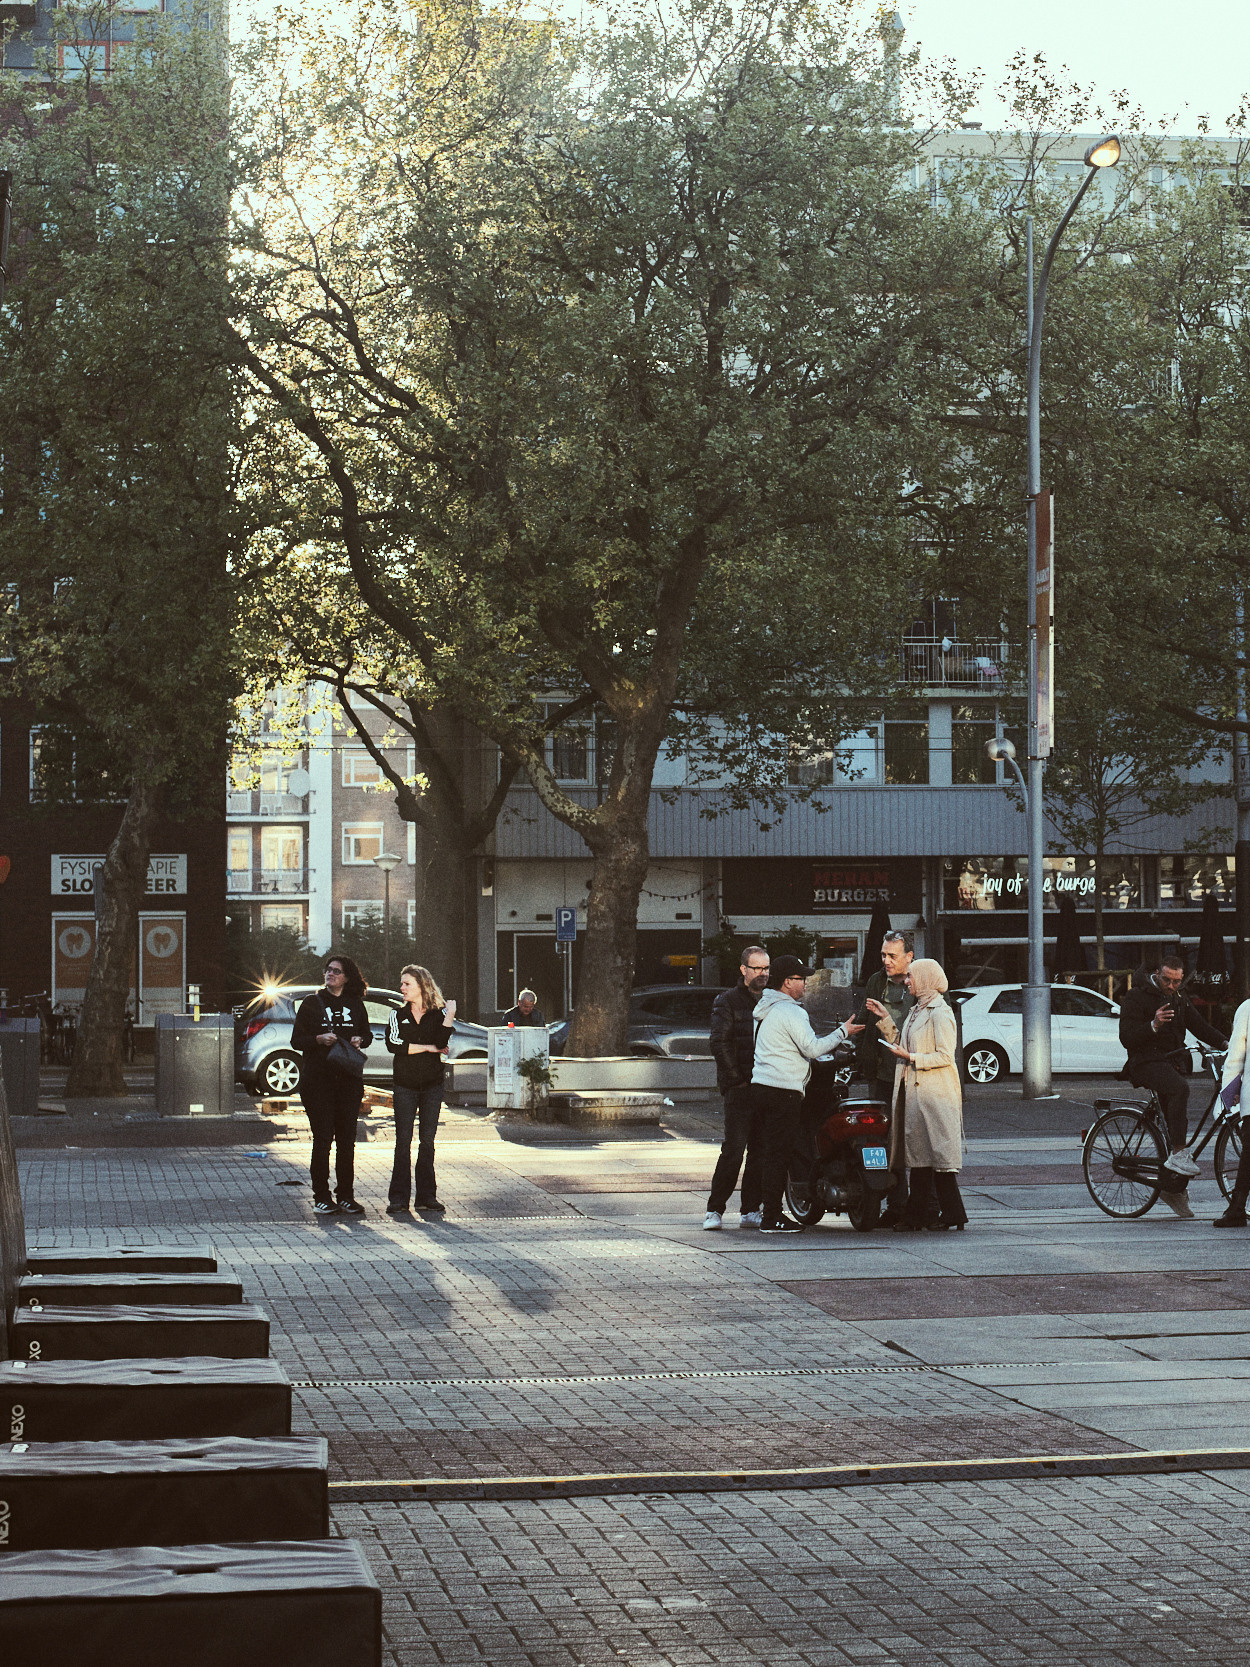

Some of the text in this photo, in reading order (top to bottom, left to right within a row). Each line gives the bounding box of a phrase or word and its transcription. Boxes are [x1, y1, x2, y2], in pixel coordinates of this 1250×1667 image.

[60, 861, 177, 875] FYSIAPIE
[61, 878, 177, 892] SLOEER
[813, 871, 890, 886] MERAM
[980, 873, 1003, 897] joy
[1006, 873, 1024, 896] of
[1056, 872, 1097, 896] burge
[813, 888, 891, 902] BURGER
[561, 910, 572, 927] P
[29, 1341, 42, 1360] XO
[11, 1404, 26, 1441] NEXO
